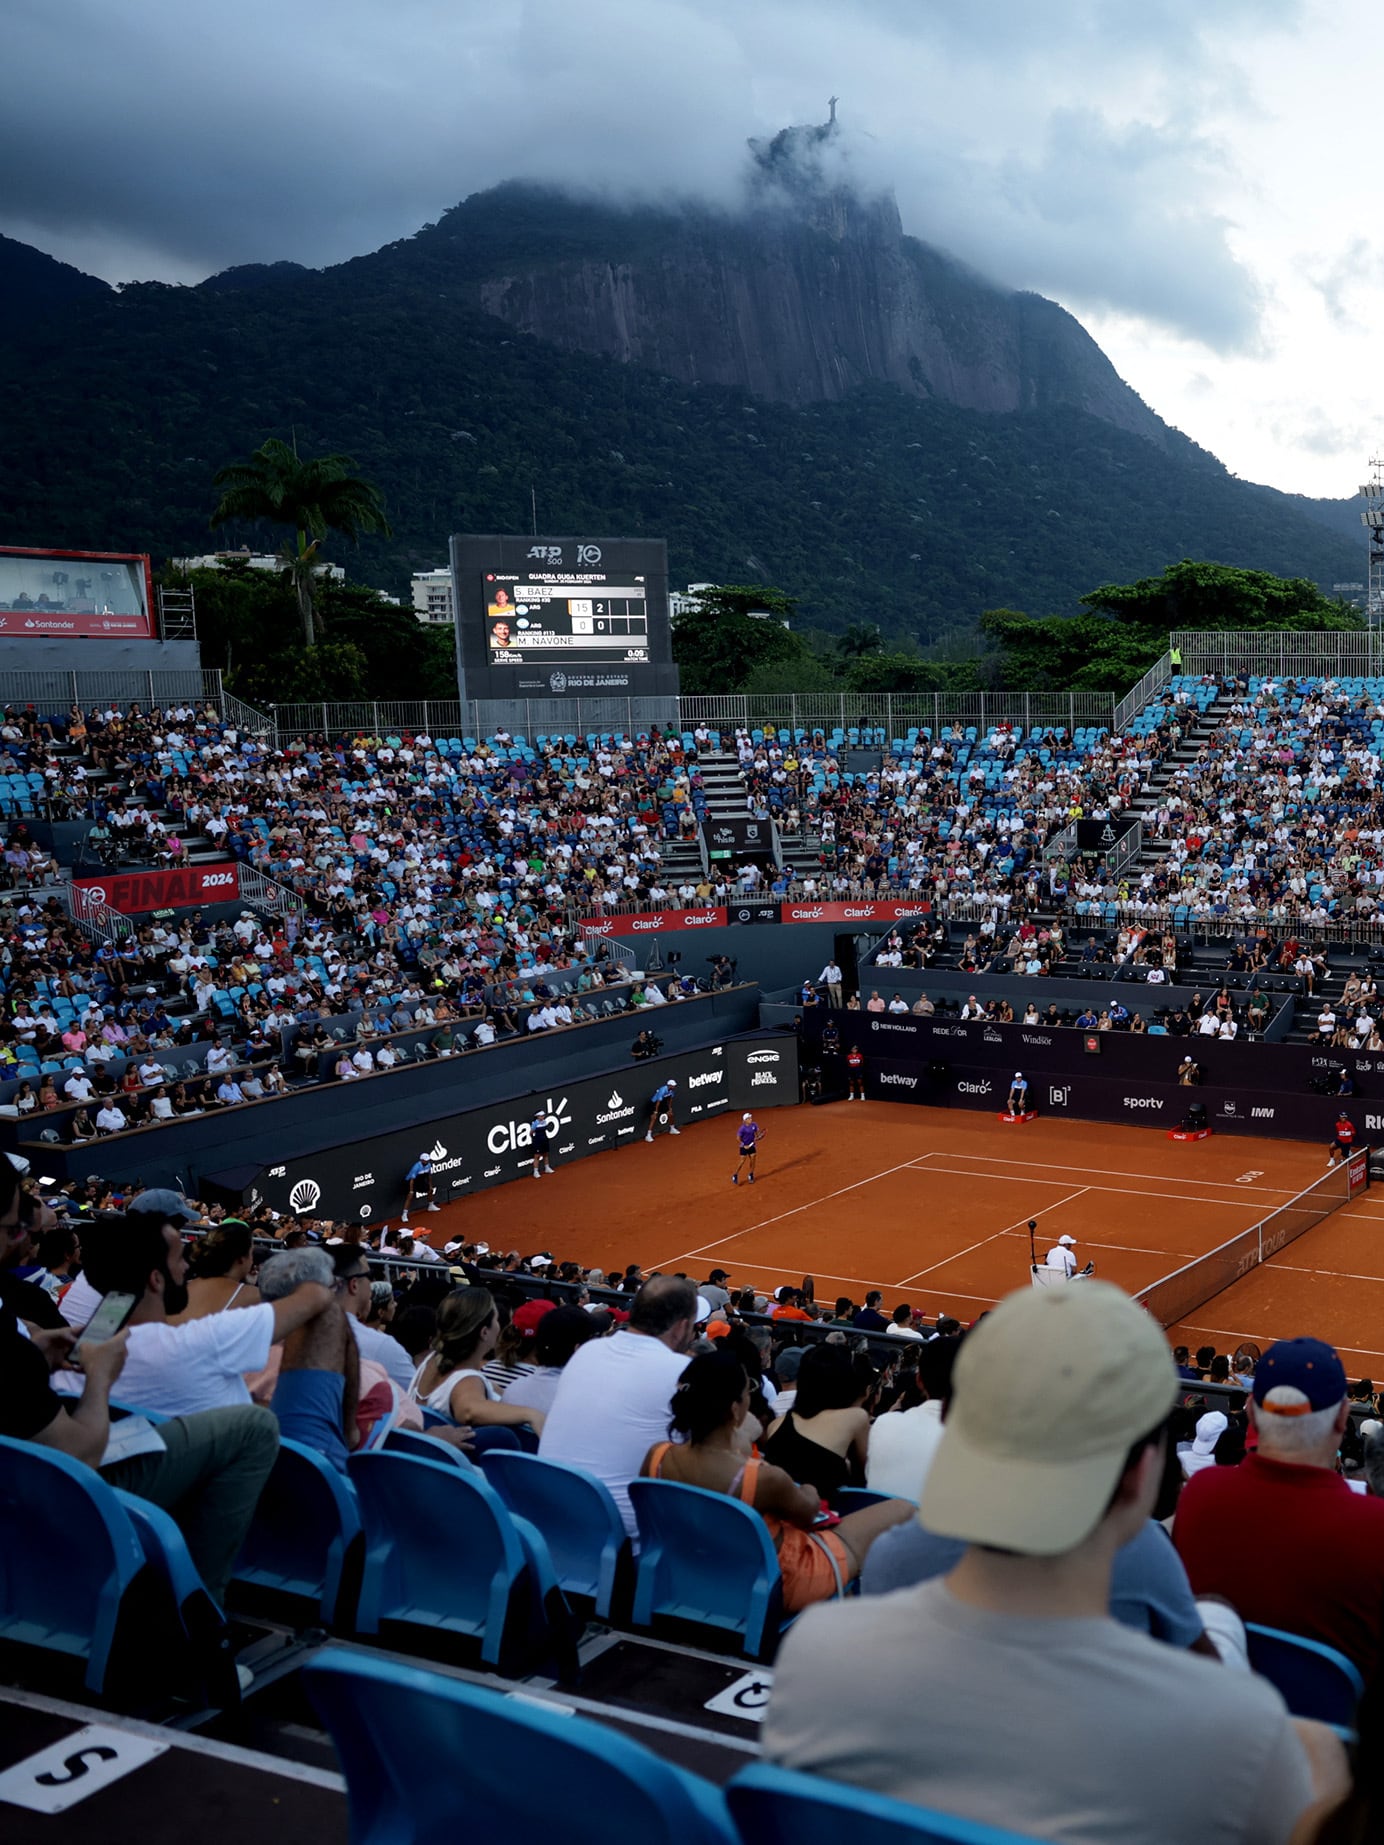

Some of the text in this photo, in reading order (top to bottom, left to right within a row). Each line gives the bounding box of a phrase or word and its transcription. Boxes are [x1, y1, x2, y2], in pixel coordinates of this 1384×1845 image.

[527, 546, 562, 558] ATP
[528, 588, 553, 596] BAEZ
[576, 604, 603, 612] 15 2
[35, 620, 74, 628] Santander
[580, 621, 604, 630] 0 0
[113, 872, 234, 906] FINAL 2024
[792, 908, 822, 919] Claro
[844, 907, 873, 917] Claro
[894, 907, 921, 916] Claro
[632, 918, 662, 929] Claro
[684, 914, 715, 925] Claro
[933, 1027, 950, 1035] REDE
[1022, 1034, 1052, 1045] Windsor
[689, 1070, 723, 1088] betway
[880, 1073, 917, 1088] betway
[958, 1080, 990, 1094] Claro
[1123, 1097, 1164, 1109] sportv
[596, 1106, 635, 1124] Santander
[1251, 1107, 1274, 1118] IMM
[488, 1106, 567, 1154] Clao
[559, 1144, 575, 1154] Claro
[431, 1157, 462, 1174] tander
[484, 1167, 500, 1177] Claro
[352, 1179, 375, 1190] JANEIRO
[1262, 1230, 1285, 1254] TOUR
[35, 1746, 118, 1786] S
